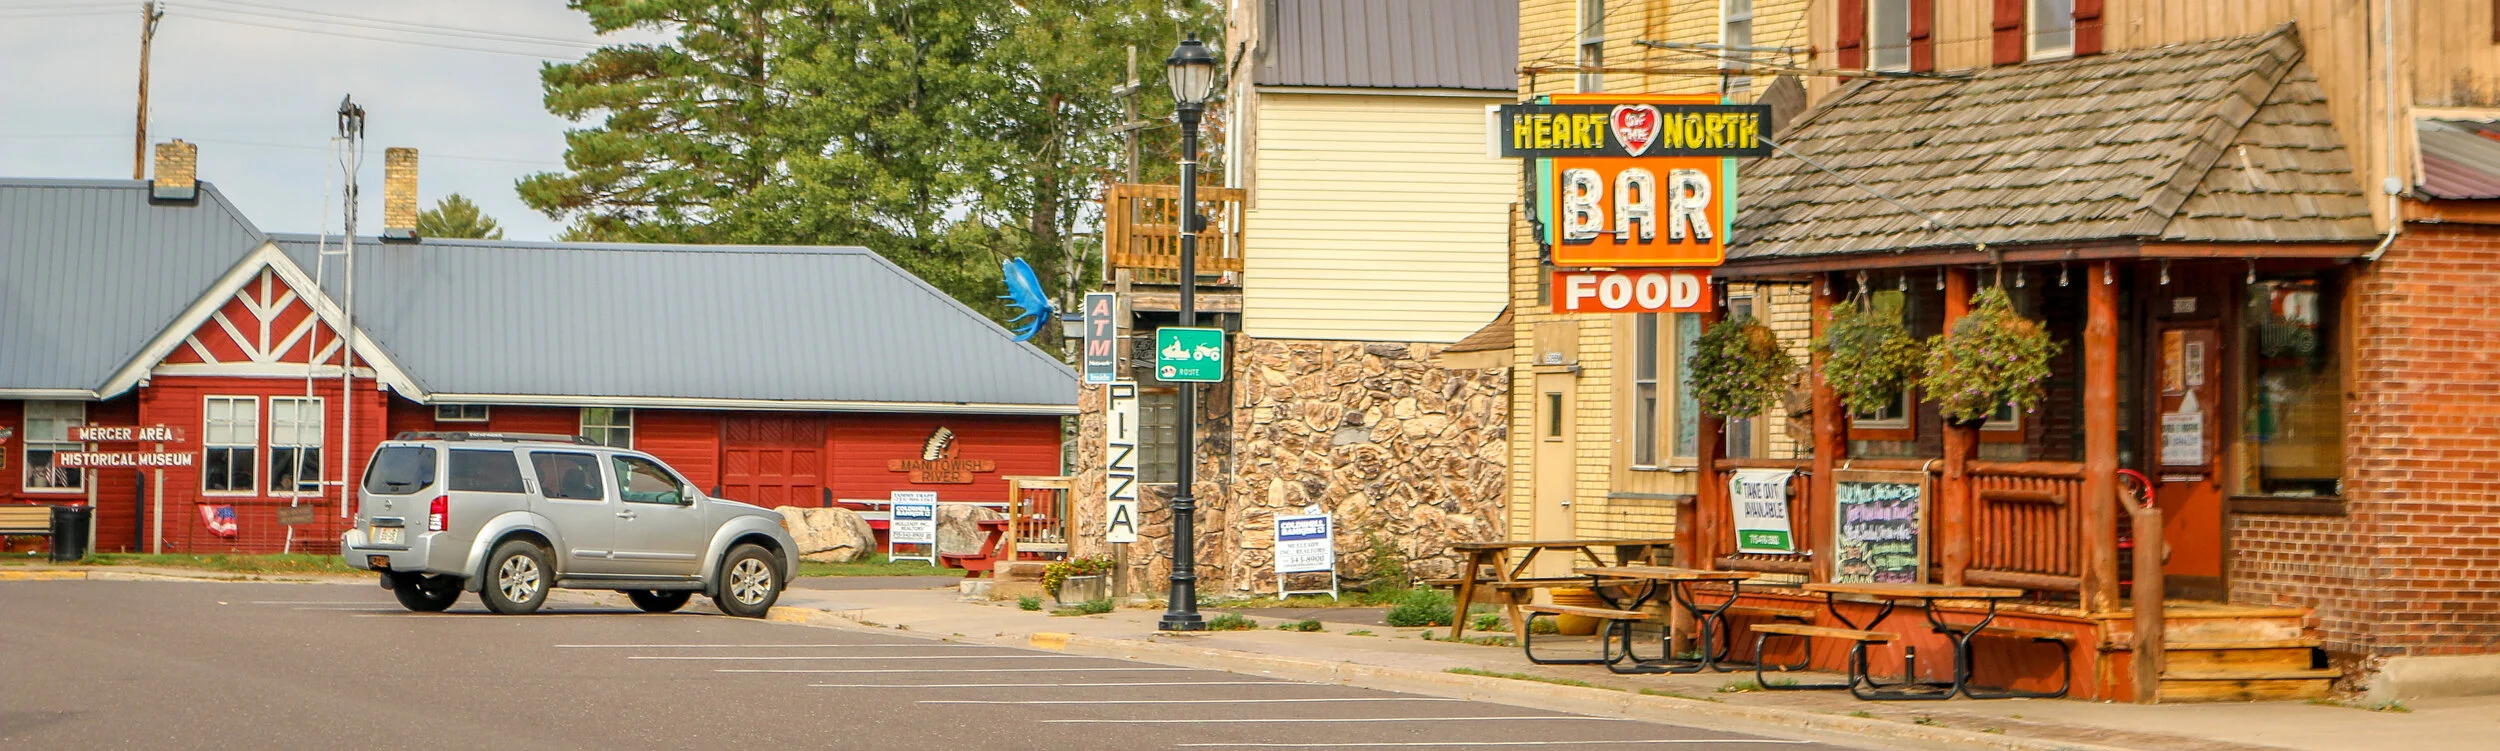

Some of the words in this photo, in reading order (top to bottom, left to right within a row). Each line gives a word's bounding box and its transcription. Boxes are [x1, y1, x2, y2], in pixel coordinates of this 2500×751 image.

[1624, 112, 1646, 127] OF
[1513, 113, 1608, 149] HEART
[1620, 127, 1649, 143] THE
[1663, 113, 1760, 149] NORTH
[1562, 167, 1713, 242] BAR
[1566, 273, 1700, 310] FOOD
[1088, 298, 1112, 357] ATM
[1178, 368, 1200, 377] ROUTE
[79, 427, 132, 441] MERCER
[138, 427, 173, 441] AREA
[60, 453, 136, 466] HISTORICAL
[138, 453, 192, 466] MUSEUM
[901, 460, 982, 471] MANITOWISH
[1108, 384, 1135, 534] PIZZA
[922, 471, 960, 482] RIVER
[1743, 482, 1762, 499] TAKE
[1763, 482, 1778, 499] OUT
[1744, 502, 1784, 518] AVAILABLE
